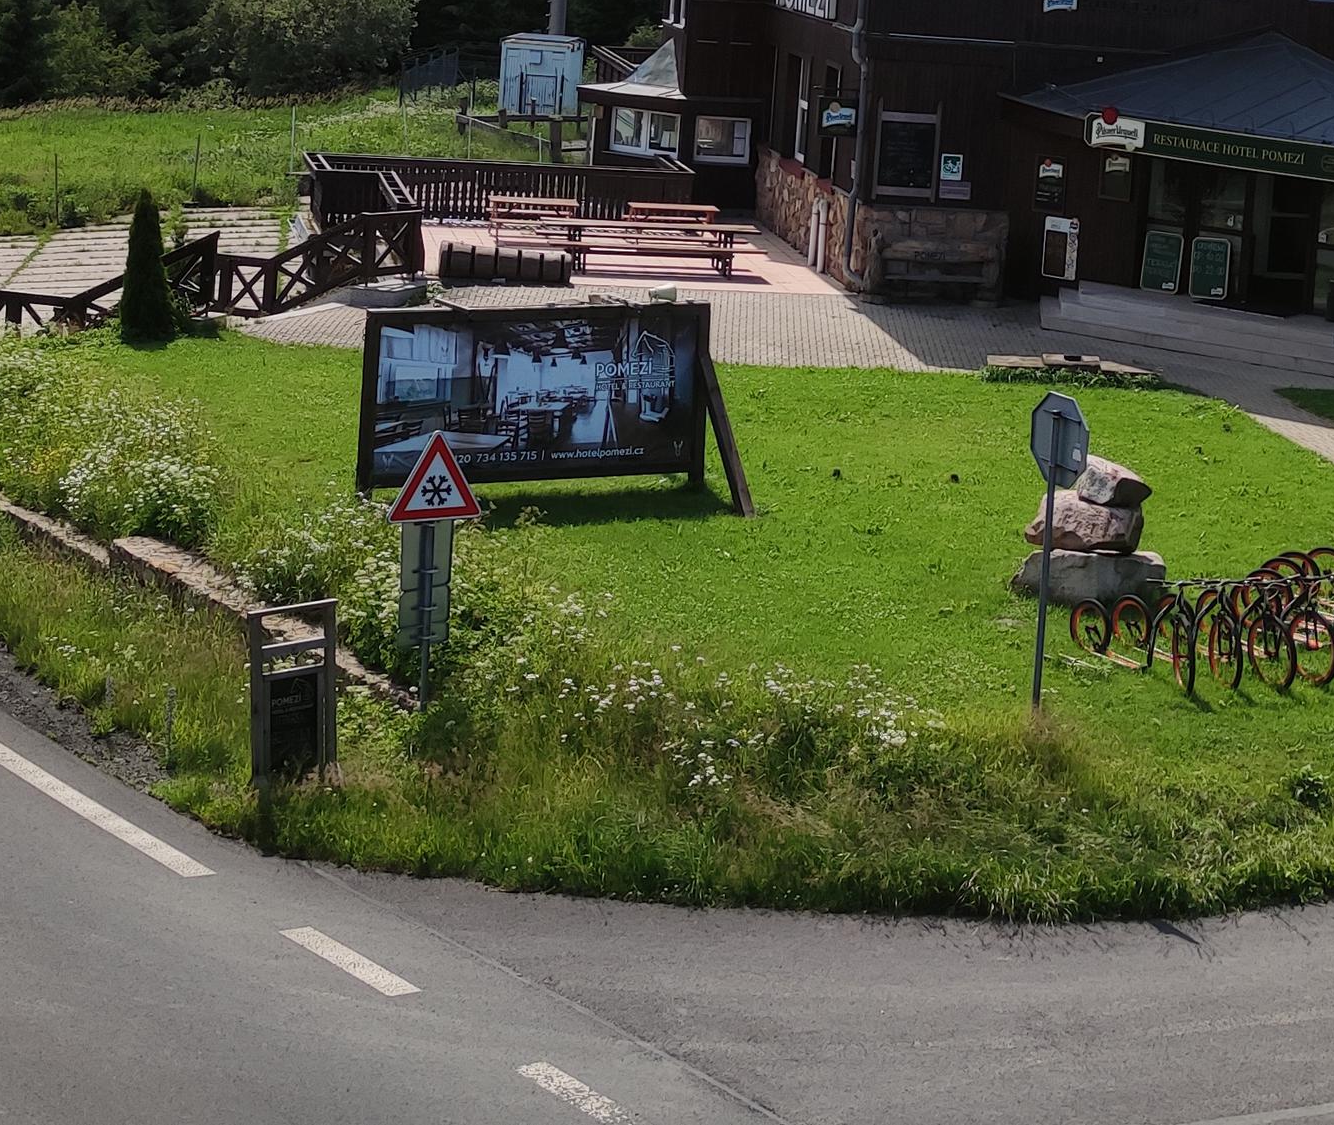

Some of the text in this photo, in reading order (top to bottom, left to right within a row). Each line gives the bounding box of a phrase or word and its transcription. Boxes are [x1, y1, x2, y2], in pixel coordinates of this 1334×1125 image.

[1153, 134, 1220, 154] RESTAURACE
[1222, 144, 1259, 160] HOTEL
[1261, 150, 1306, 166] POMEZÍ
[596, 358, 652, 377] POMEZÍ
[596, 382, 620, 390] HOTEL
[628, 380, 675, 390] RESTAURANT
[476, 453, 496, 463] 734
[499, 452, 517, 462] 135
[519, 451, 538, 461] 715
